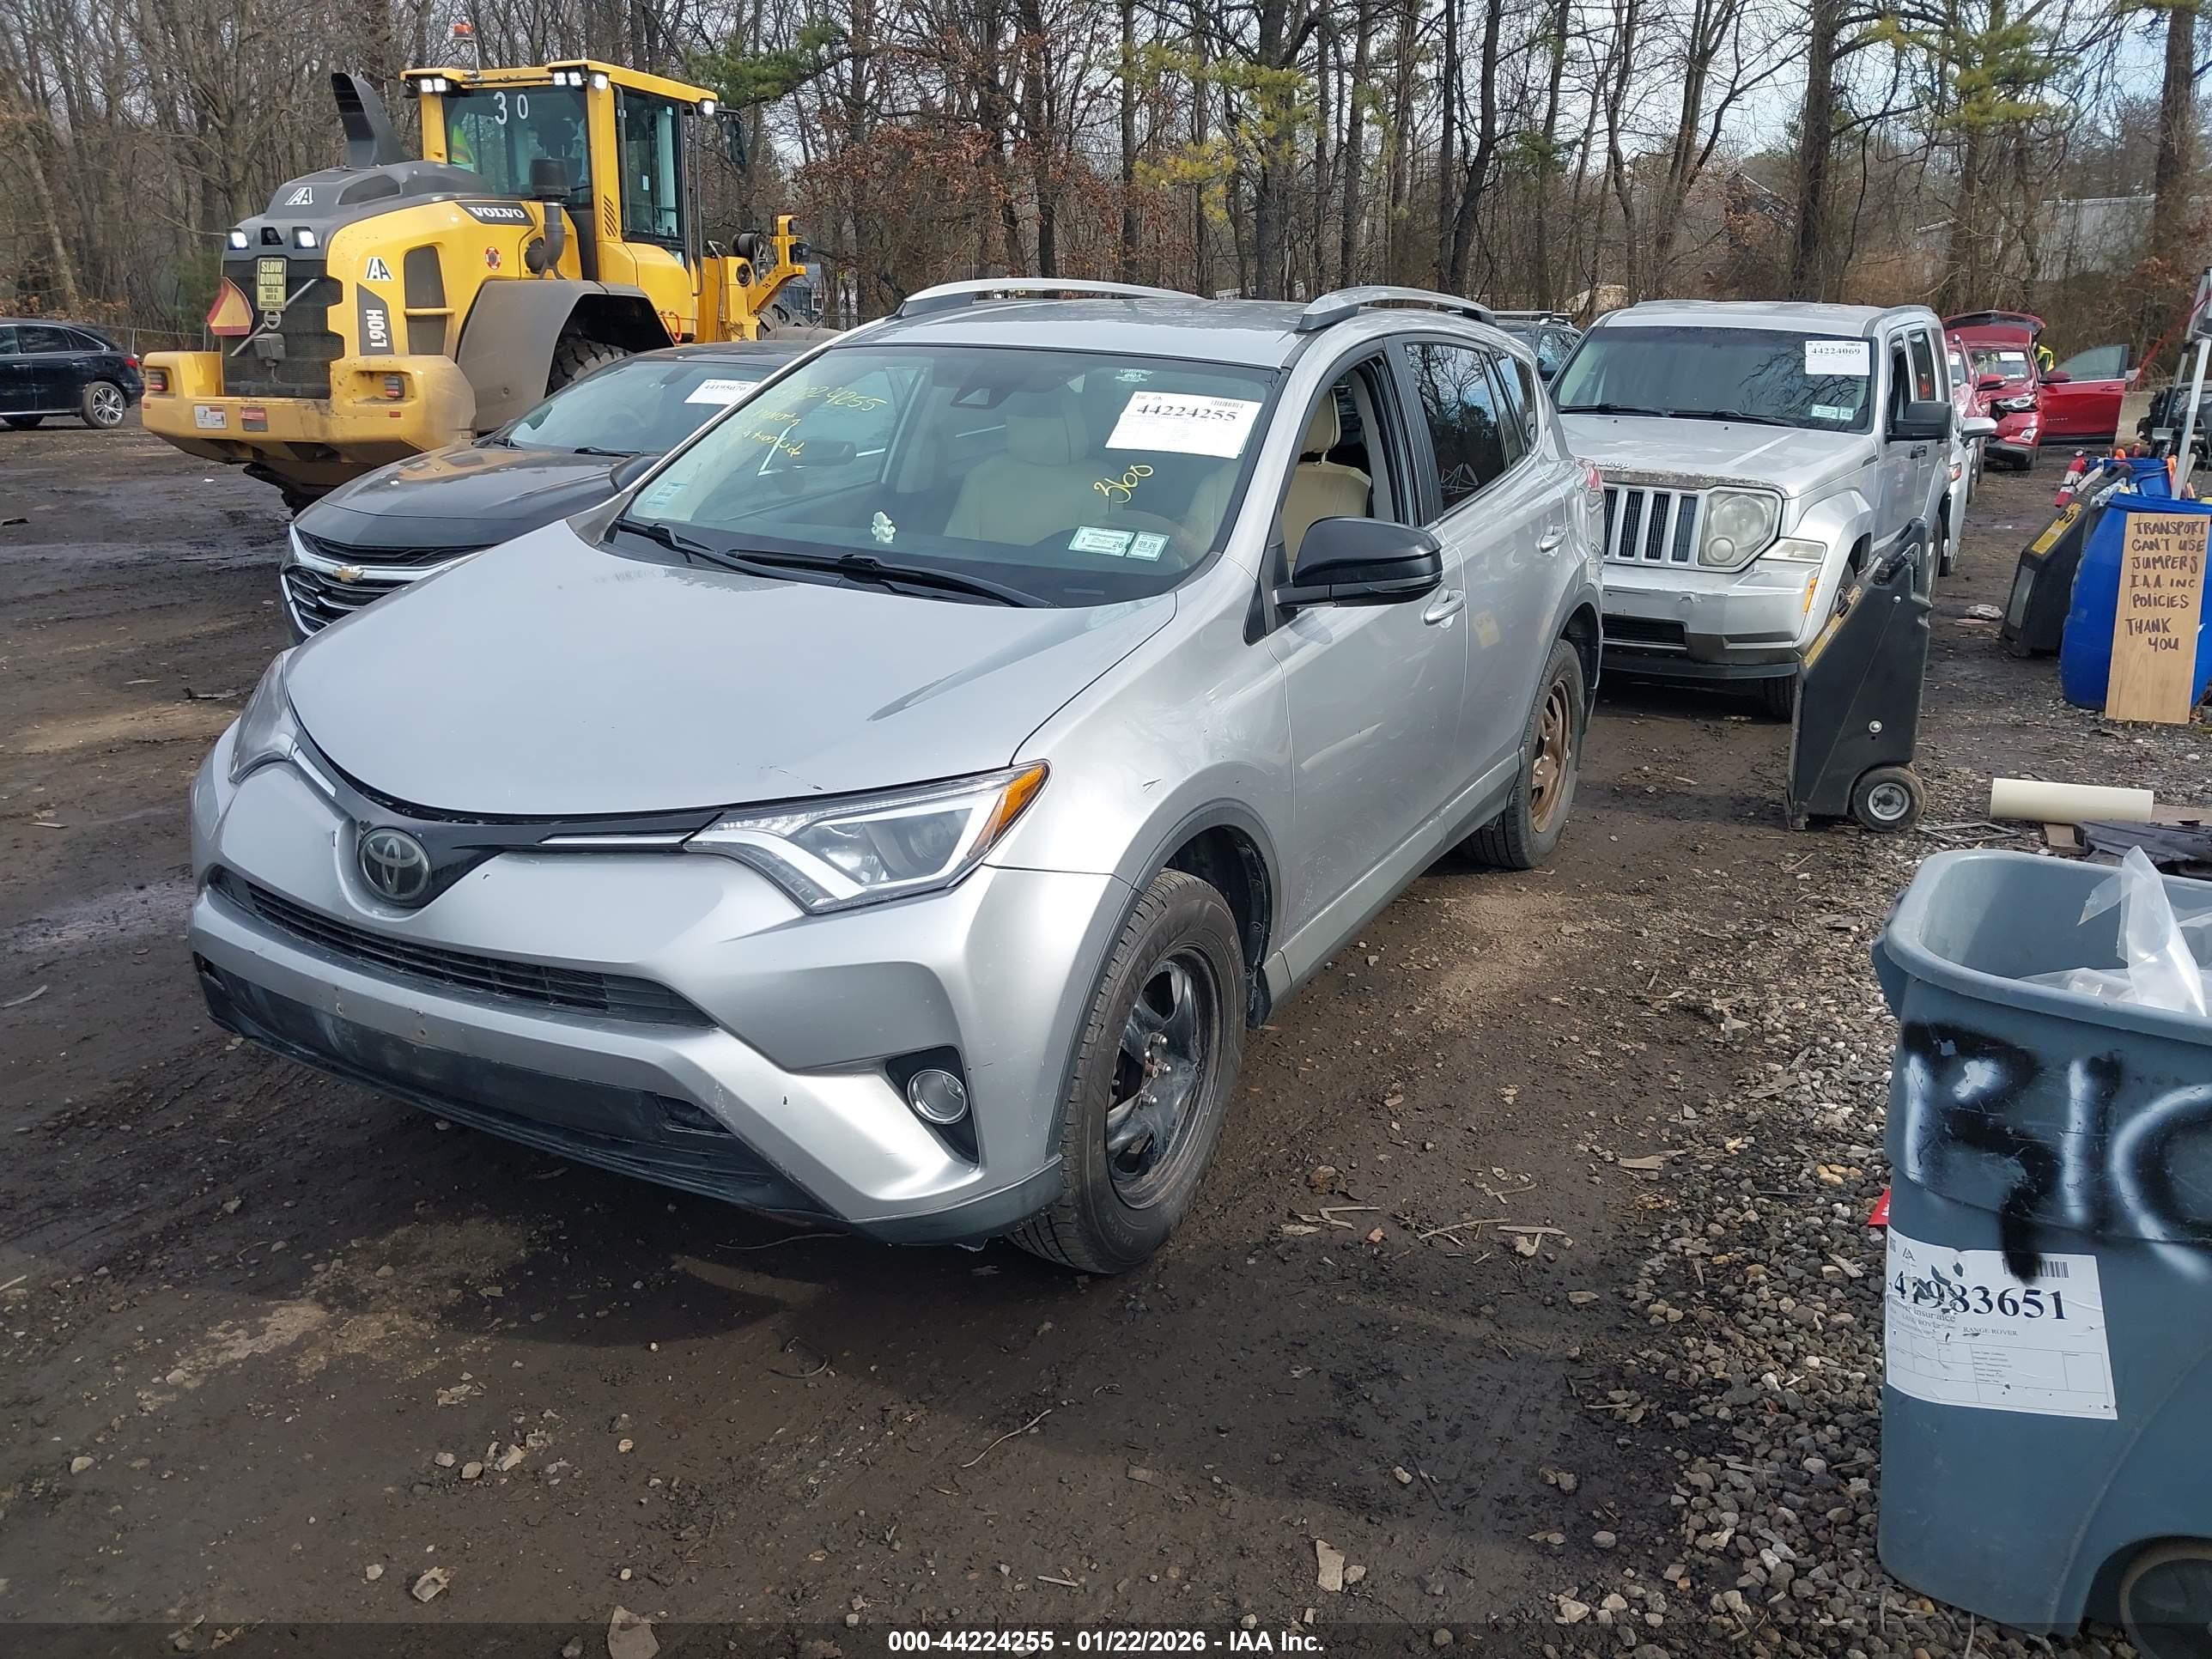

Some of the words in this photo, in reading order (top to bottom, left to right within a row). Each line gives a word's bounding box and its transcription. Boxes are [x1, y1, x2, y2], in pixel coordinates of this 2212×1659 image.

[467, 206, 526, 219] VOLVO
[261, 261, 283, 273] SLOW
[260, 273, 283, 285] DOWN
[366, 309, 388, 347] L90H
[1137, 404, 1237, 422] 44224255
[1094, 465, 1154, 503] 360
[2134, 520, 2207, 536] TRANSPORT
[2131, 538, 2170, 551] CAN'T
[2179, 539, 2206, 552] USE
[2130, 555, 2198, 574] JUMPERS
[2125, 617, 2172, 636] THANK
[2148, 636, 2179, 653] YOU
[1914, 1306, 1956, 1322] Insurnce
